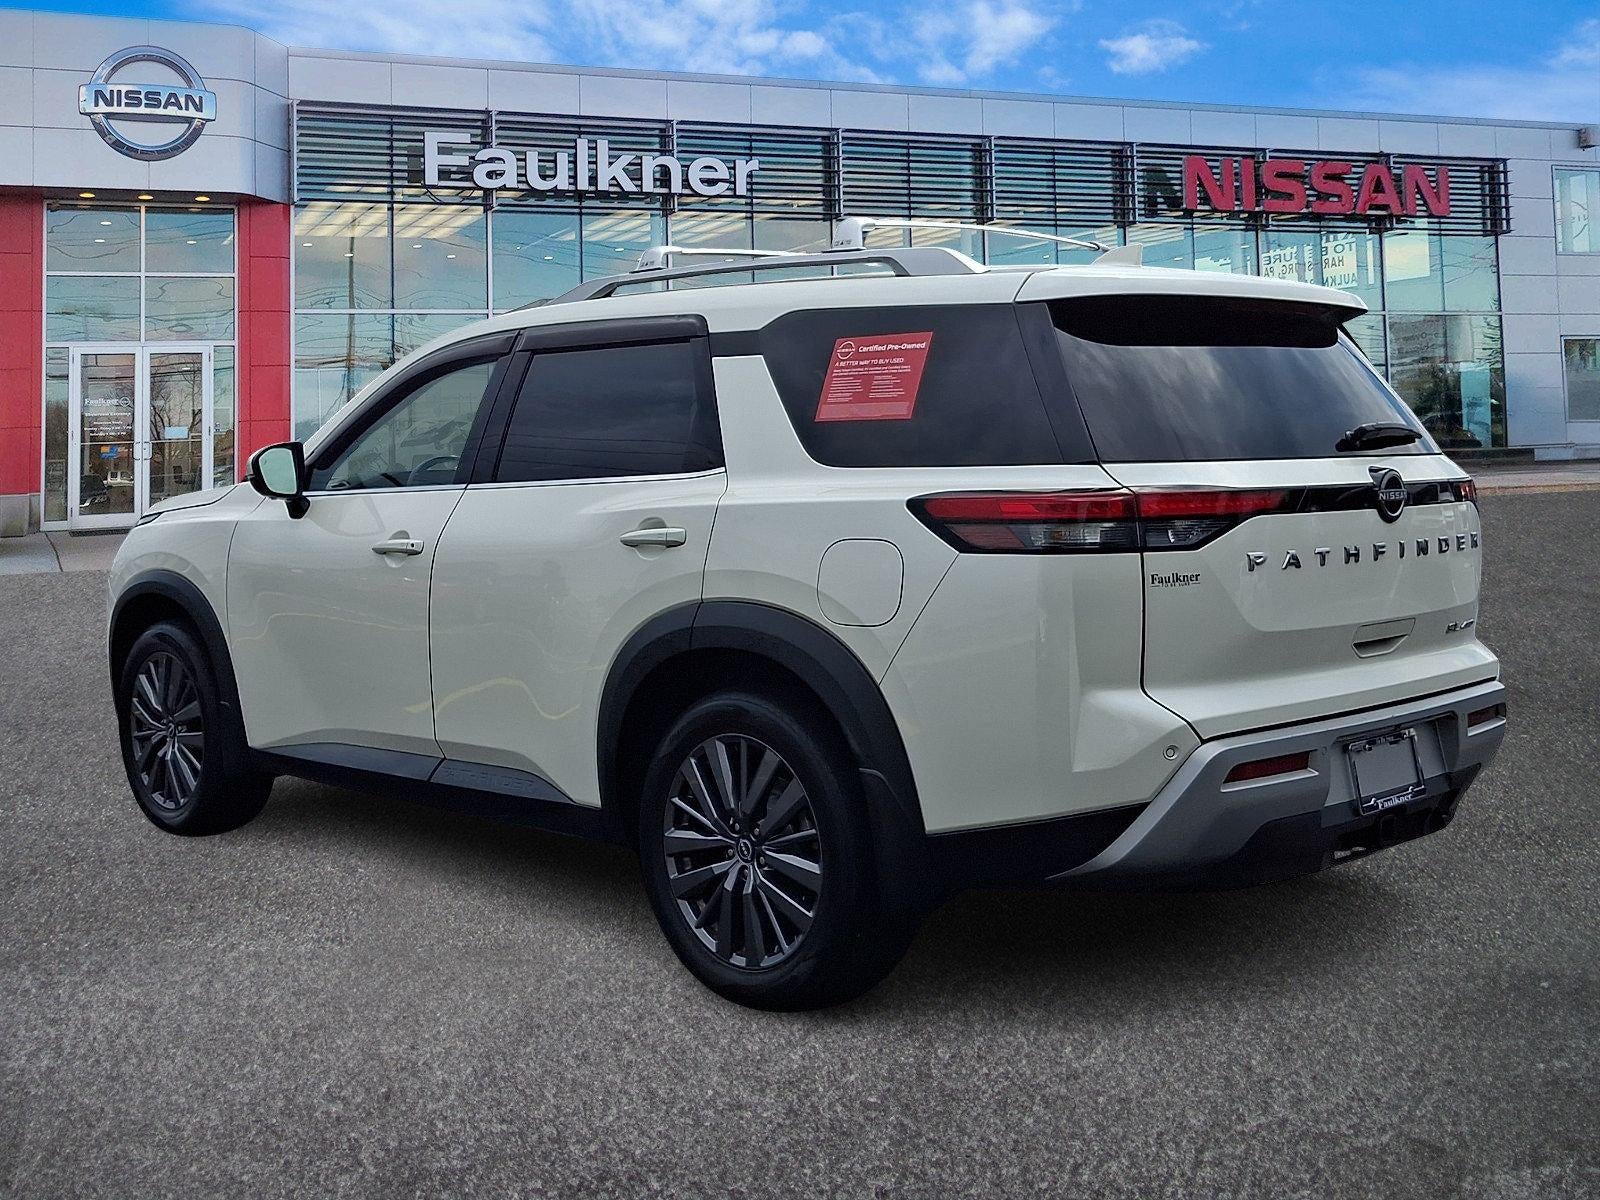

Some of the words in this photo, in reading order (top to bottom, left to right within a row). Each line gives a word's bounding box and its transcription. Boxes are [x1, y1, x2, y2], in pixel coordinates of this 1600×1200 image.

[94, 89, 203, 113] NISSAN
[423, 131, 760, 196] Faulkner
[1182, 155, 1451, 216] NISSAN
[858, 343, 886, 353] Certified
[886, 341, 926, 351] Pre-Owned
[1246, 531, 1479, 572] PATHFINDER
[1150, 572, 1201, 585] Faulkner
[1377, 794, 1412, 809] Faulkner
